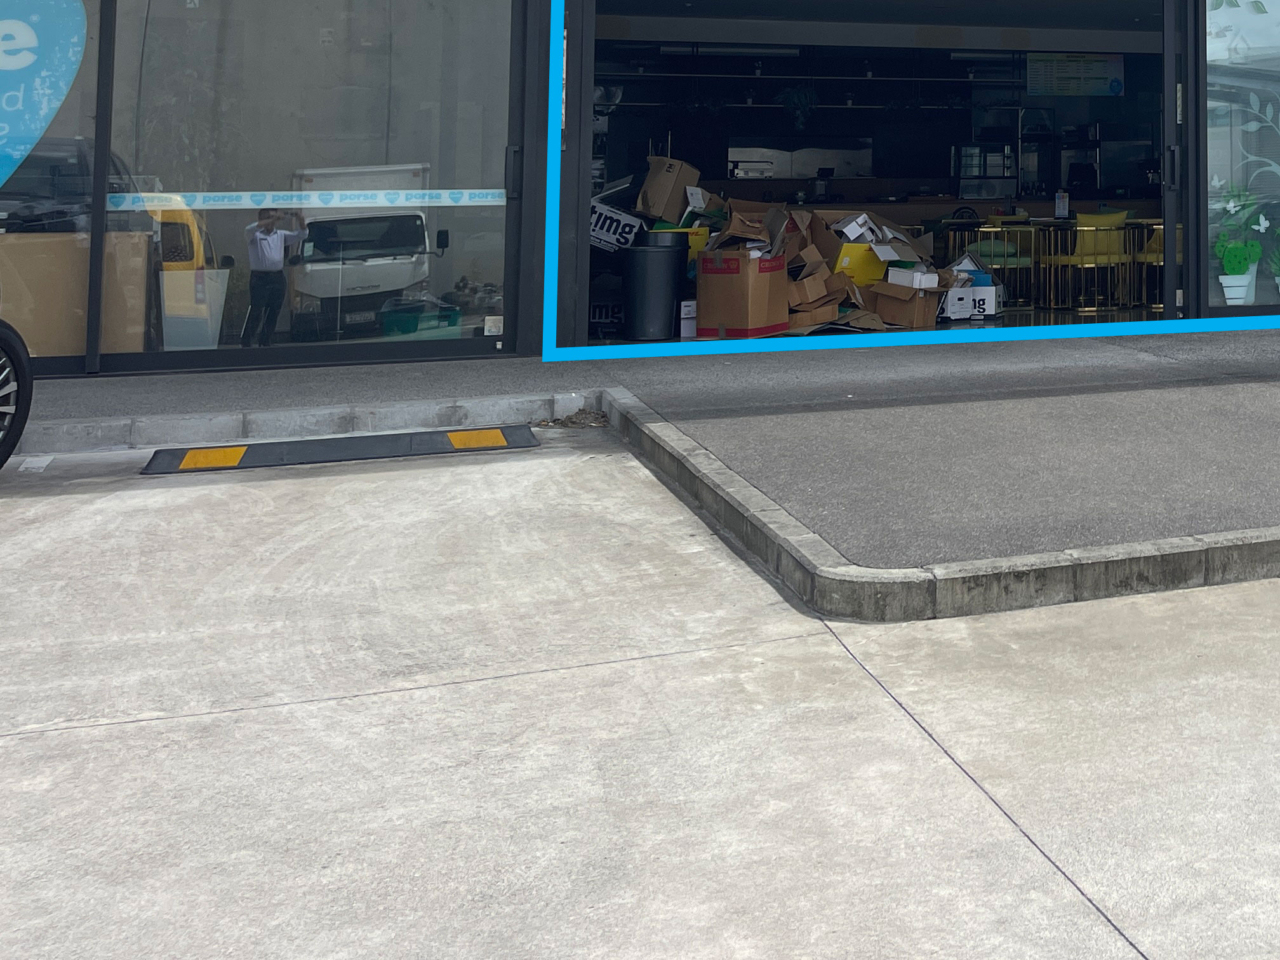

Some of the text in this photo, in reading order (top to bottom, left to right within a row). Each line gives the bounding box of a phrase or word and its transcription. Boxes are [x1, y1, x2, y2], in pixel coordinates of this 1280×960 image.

[202, 193, 242, 204] porse
[271, 192, 311, 203] porse
[339, 192, 378, 202] porse
[405, 191, 442, 202] porse
